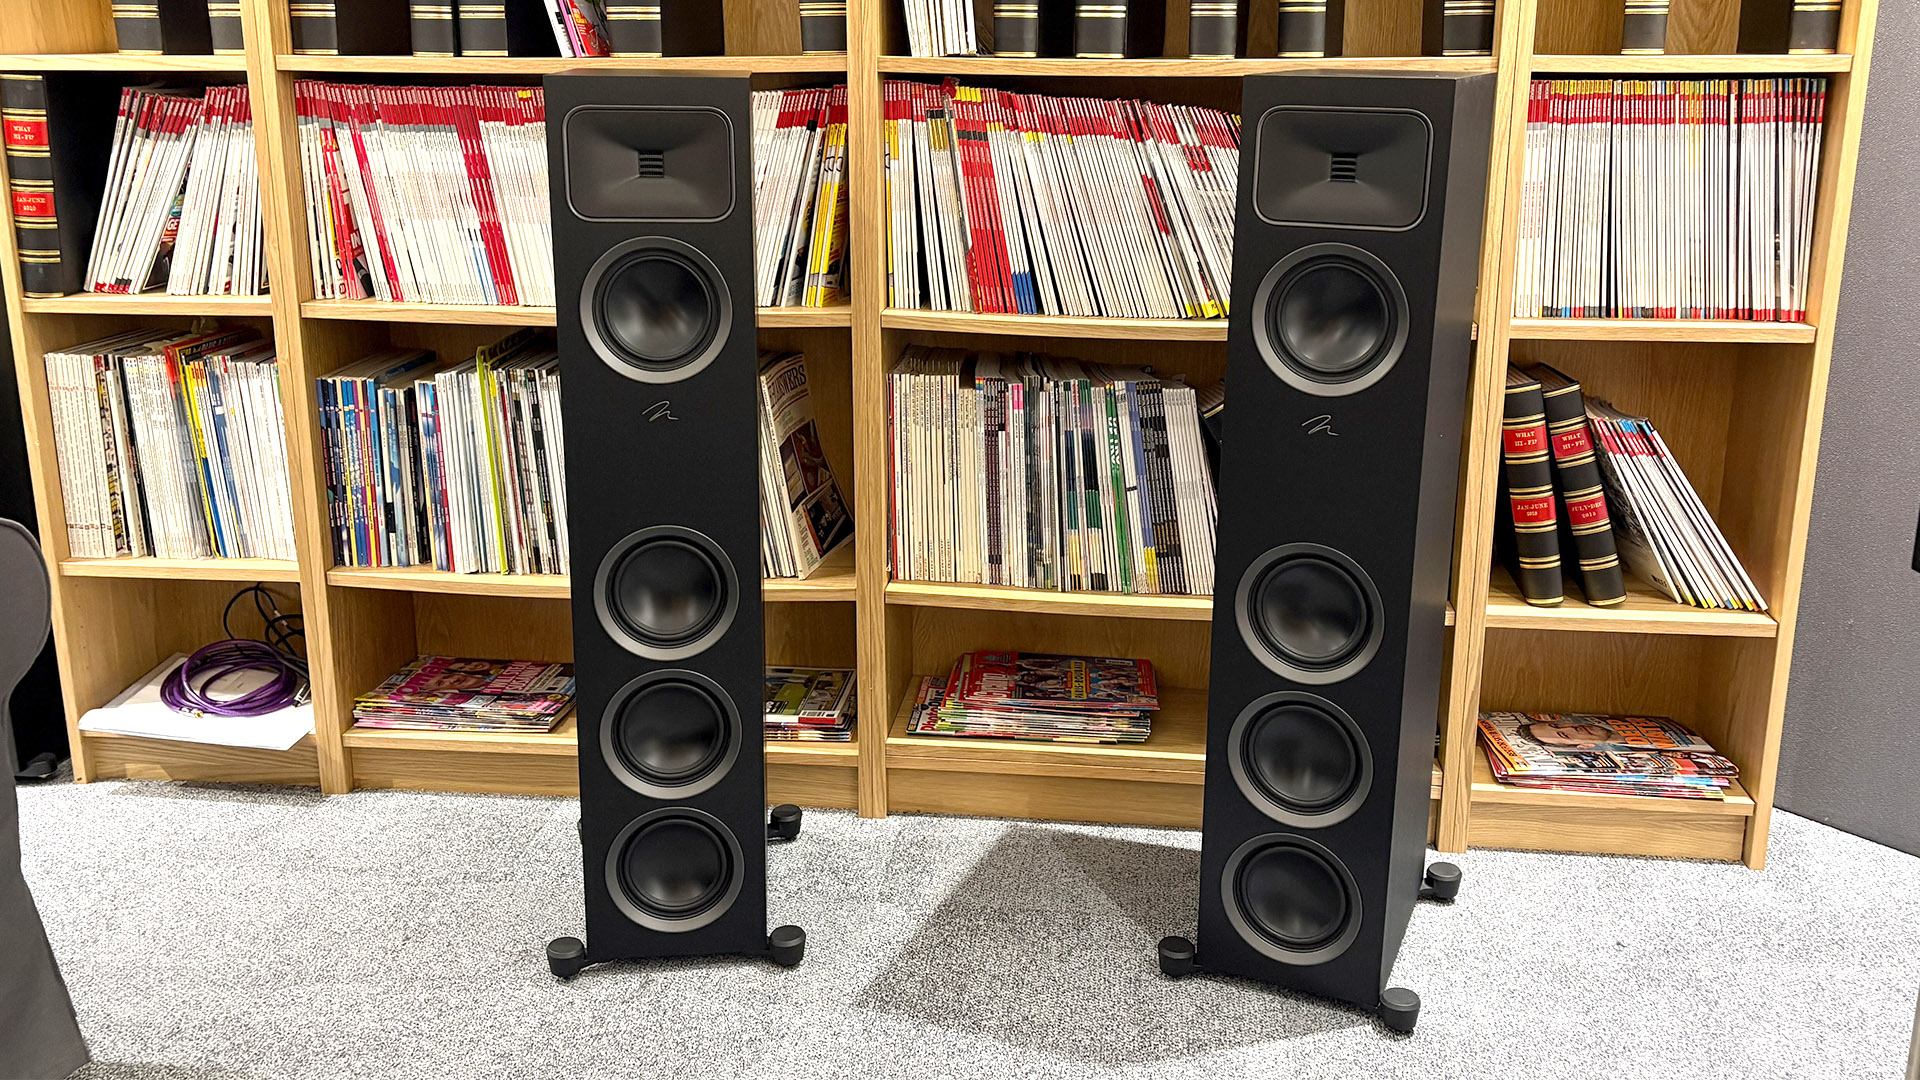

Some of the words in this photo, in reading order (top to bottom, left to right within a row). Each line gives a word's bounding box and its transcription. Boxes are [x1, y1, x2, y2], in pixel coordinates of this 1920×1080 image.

[1515, 430, 1536, 439] WHAT
[1562, 432, 1582, 442] WHAT
[1516, 502, 1549, 511] JAN-JUNE
[1571, 501, 1604, 513] JULY-DEC
[1606, 719, 1651, 745] DEEP
[1625, 717, 1679, 749] WATER
